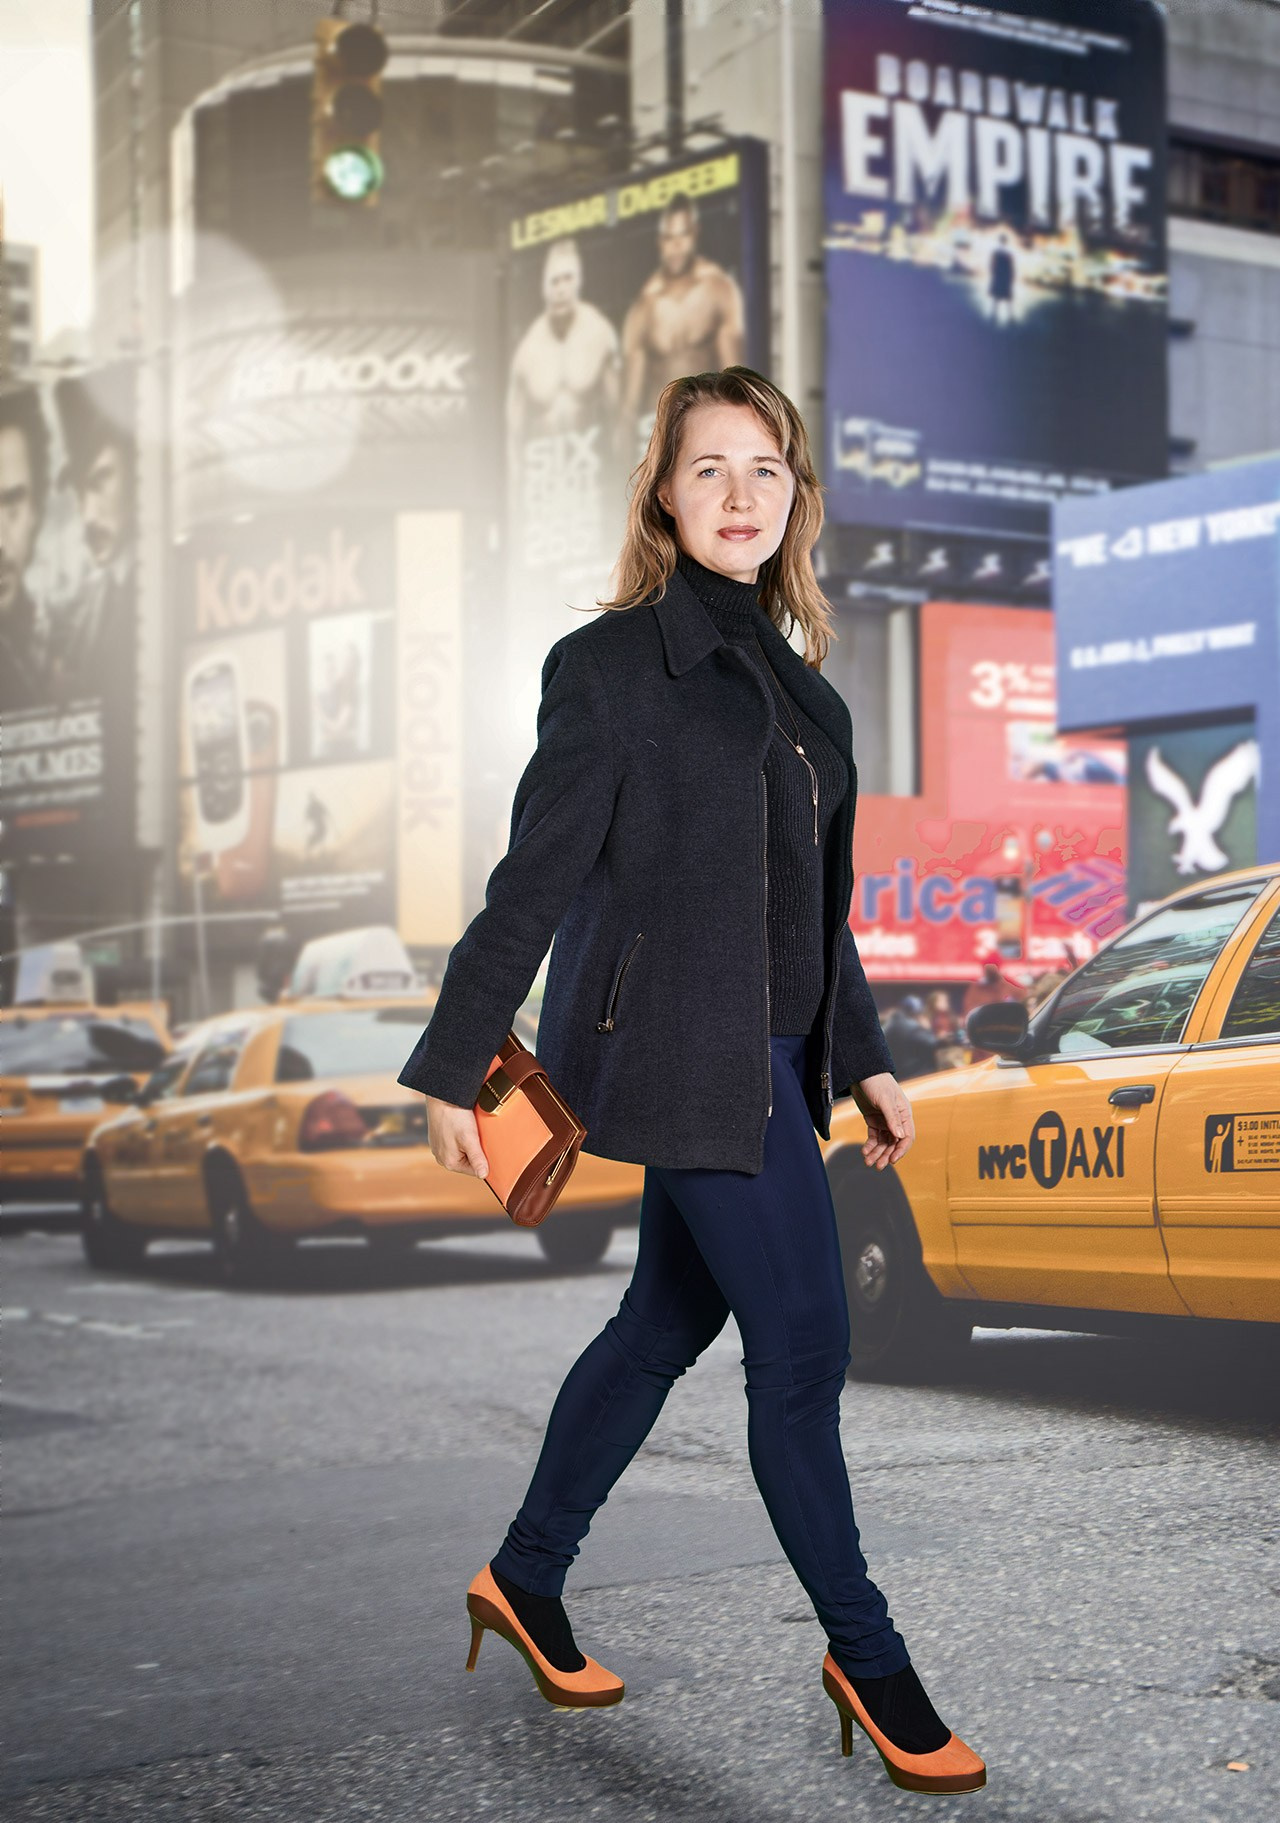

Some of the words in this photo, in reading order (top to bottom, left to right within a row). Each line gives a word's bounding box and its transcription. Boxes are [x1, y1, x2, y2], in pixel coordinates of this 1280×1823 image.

[876, 54, 1119, 139] BOARDWALK
[841, 89, 1152, 230] EMPIRE
[197, 528, 367, 633] Kodak
[404, 631, 456, 834] Kodak
[860, 858, 998, 925] rica
[978, 1143, 1027, 1180] NYC
[1037, 1124, 1125, 1180] TAXI
